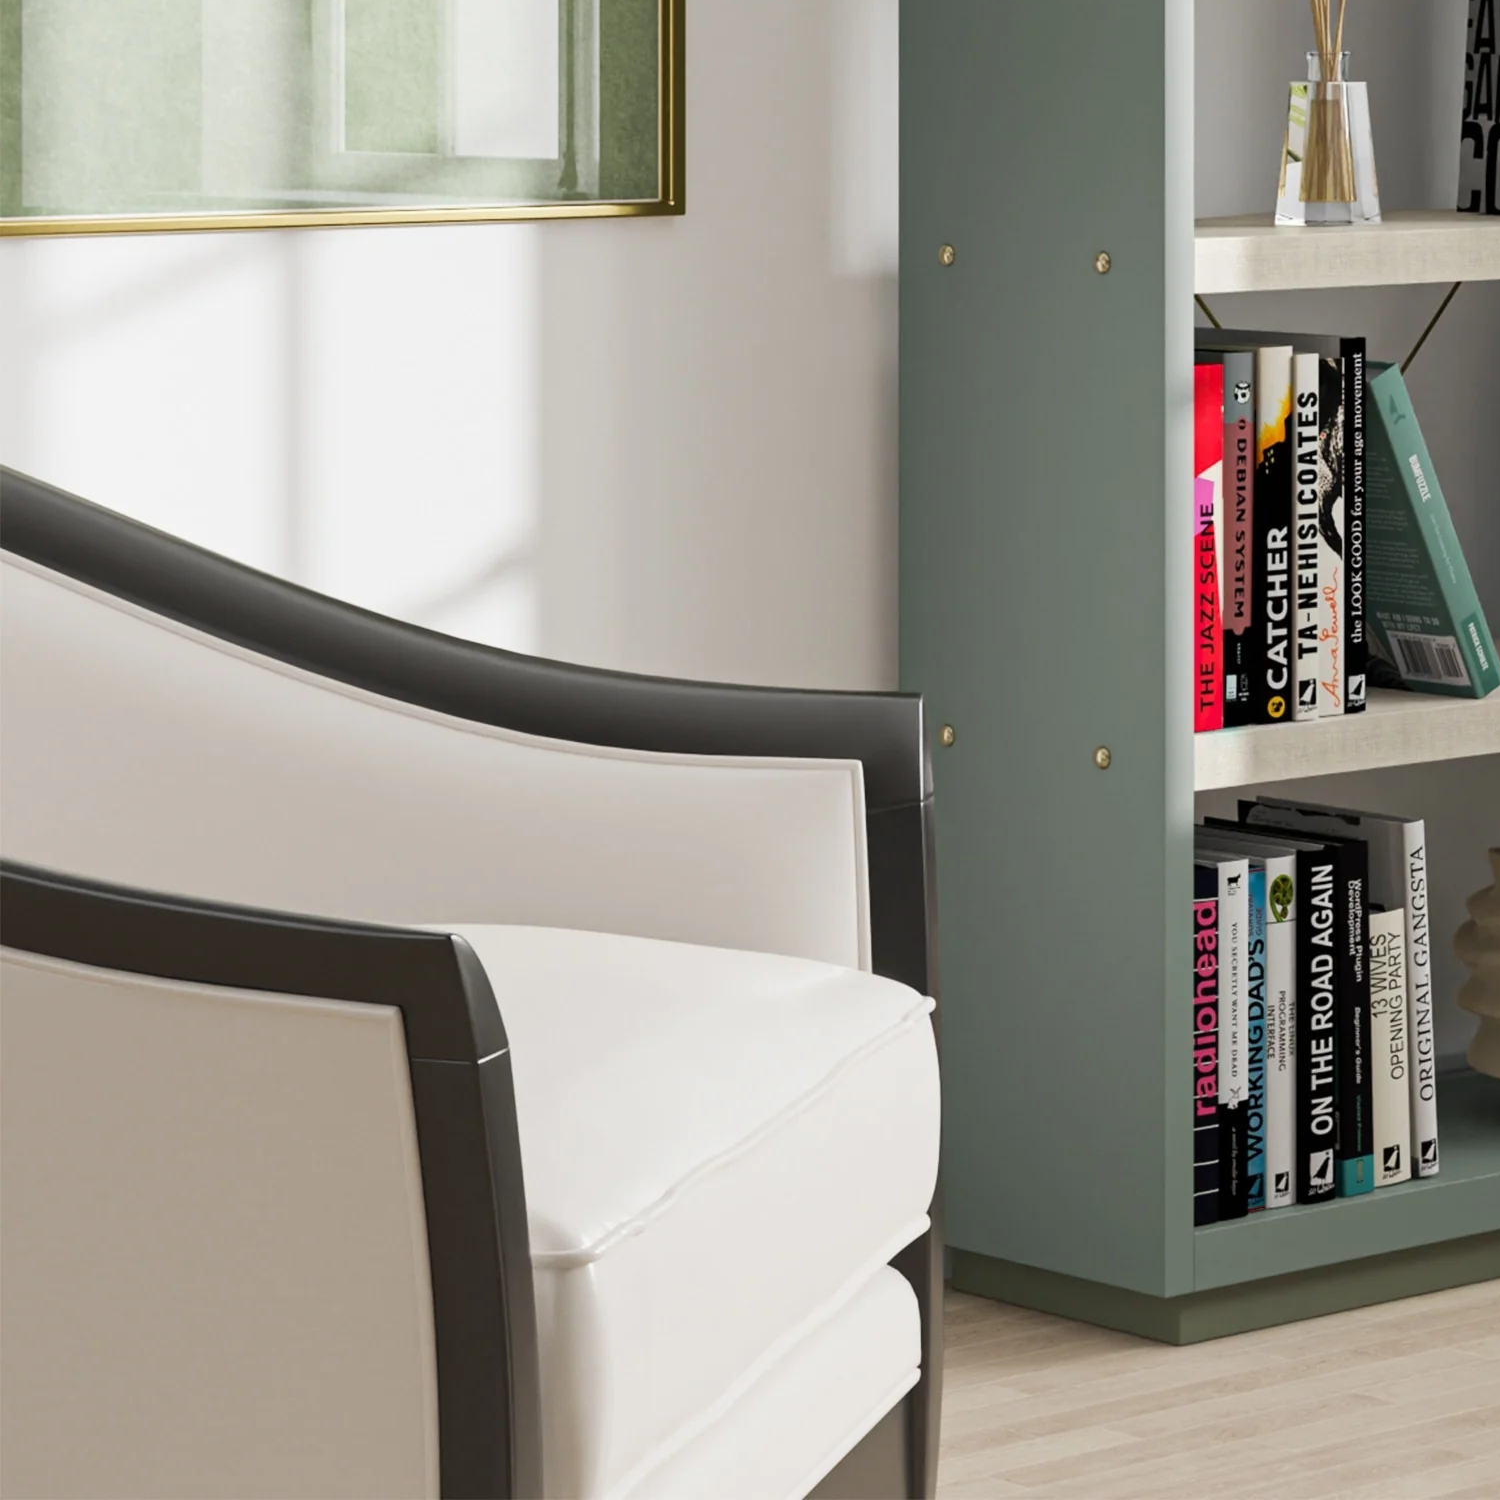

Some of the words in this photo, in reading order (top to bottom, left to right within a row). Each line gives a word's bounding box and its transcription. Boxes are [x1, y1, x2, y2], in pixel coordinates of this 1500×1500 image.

[1351, 352, 1362, 428] movement
[1297, 392, 1317, 504] COATES
[1353, 431, 1364, 456] age
[1235, 438, 1247, 523] DEBIAN
[1351, 496, 1362, 516] for
[1352, 459, 1364, 492] your
[1408, 454, 1431, 503] BUMFUZZLE
[1199, 504, 1213, 585] SCENE
[1234, 531, 1246, 618] SYSTEM
[1351, 520, 1362, 567] GOOD
[1266, 526, 1288, 690] CATCHER
[1297, 513, 1318, 659] TA-NEHISI
[1351, 571, 1362, 616] LOOK
[1200, 592, 1214, 654] JAZZ
[1351, 620, 1363, 643] the
[1200, 662, 1215, 712] THE
[1312, 864, 1333, 947] AGAIN
[1348, 880, 1356, 955] Development
[1409, 846, 1429, 967] GANGSTA
[1311, 954, 1333, 1029] ROAD
[1353, 948, 1362, 982] Plugin
[1369, 934, 1387, 995] WIVES
[1388, 932, 1402, 989] PARTY
[1193, 900, 1217, 1117] radiohead
[1231, 1030, 1238, 1045] ME
[1267, 1005, 1275, 1059] INTERFACE
[1278, 991, 1286, 1071] PROGRAMMING
[1372, 1000, 1388, 1017] 13
[1390, 996, 1404, 1080] OPENING
[1416, 974, 1434, 1101] ORIGINAL
[1248, 1025, 1264, 1158] WORKING
[1311, 1037, 1333, 1090] THE
[1311, 1095, 1333, 1135] ON
